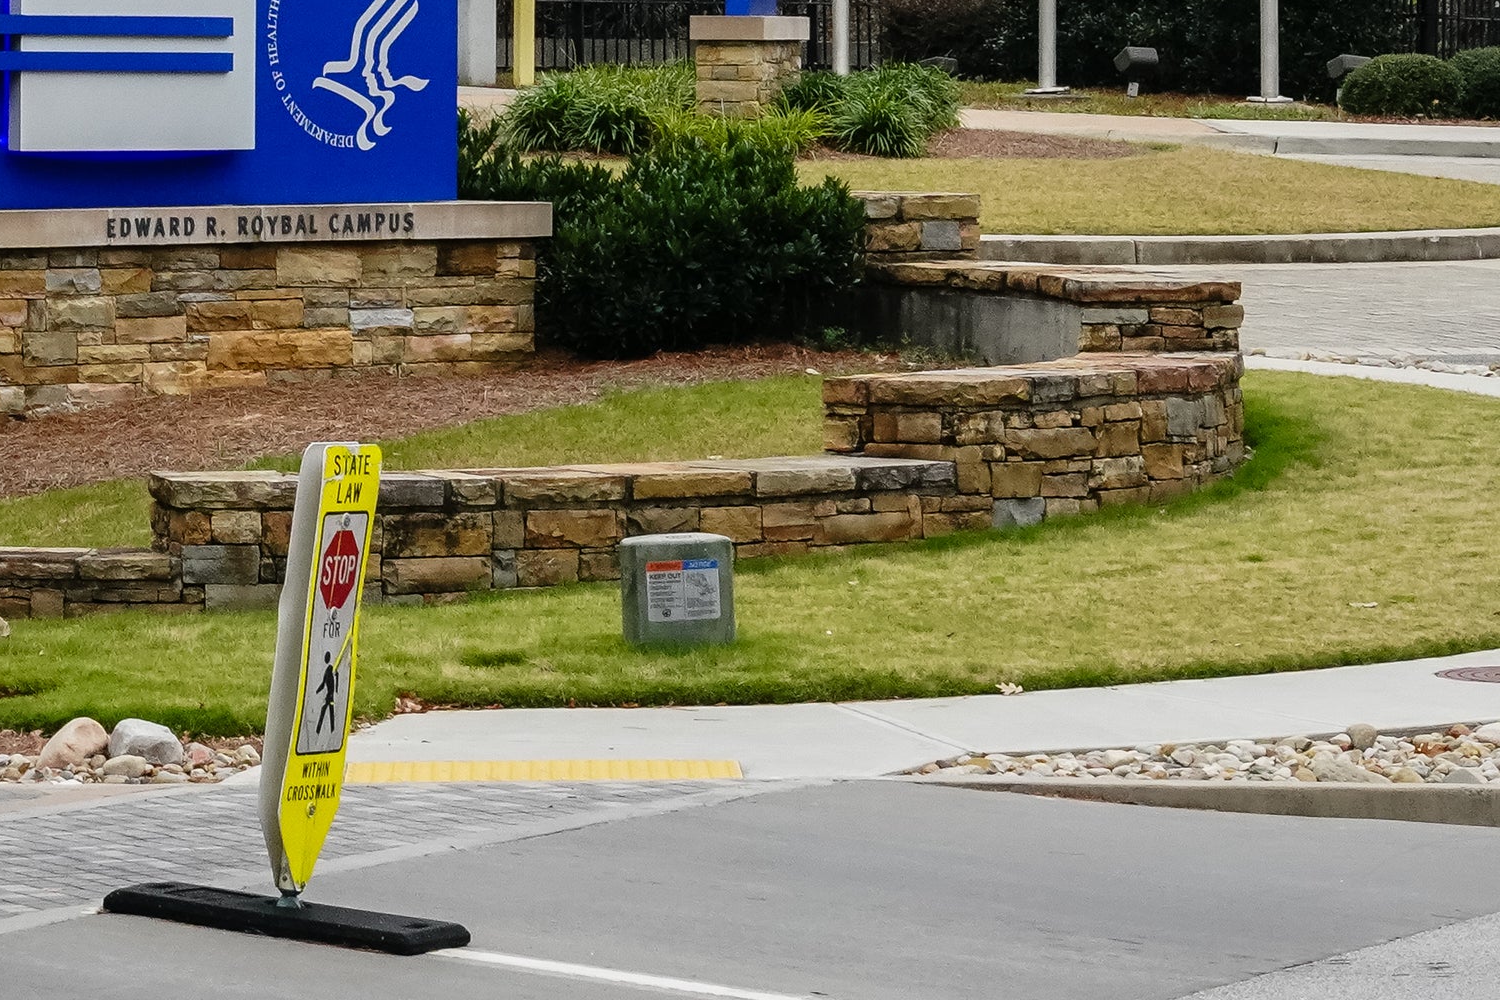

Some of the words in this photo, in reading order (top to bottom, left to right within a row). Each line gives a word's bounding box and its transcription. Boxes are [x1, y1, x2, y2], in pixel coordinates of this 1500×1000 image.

[271, 70, 286, 91] OF
[281, 93, 354, 148] DEPARTMENT
[106, 216, 195, 239] EDWARD
[206, 216, 226, 236] R.
[237, 213, 318, 236] ROYBAL
[329, 212, 415, 233] CAMPUS
[334, 454, 371, 476] STATE
[336, 482, 363, 504] LAW
[323, 554, 356, 586] STOP
[649, 572, 666, 580] KEEP
[322, 621, 341, 639] FOR
[301, 760, 330, 779] WITHIN
[286, 782, 337, 802] CROSSWALK
